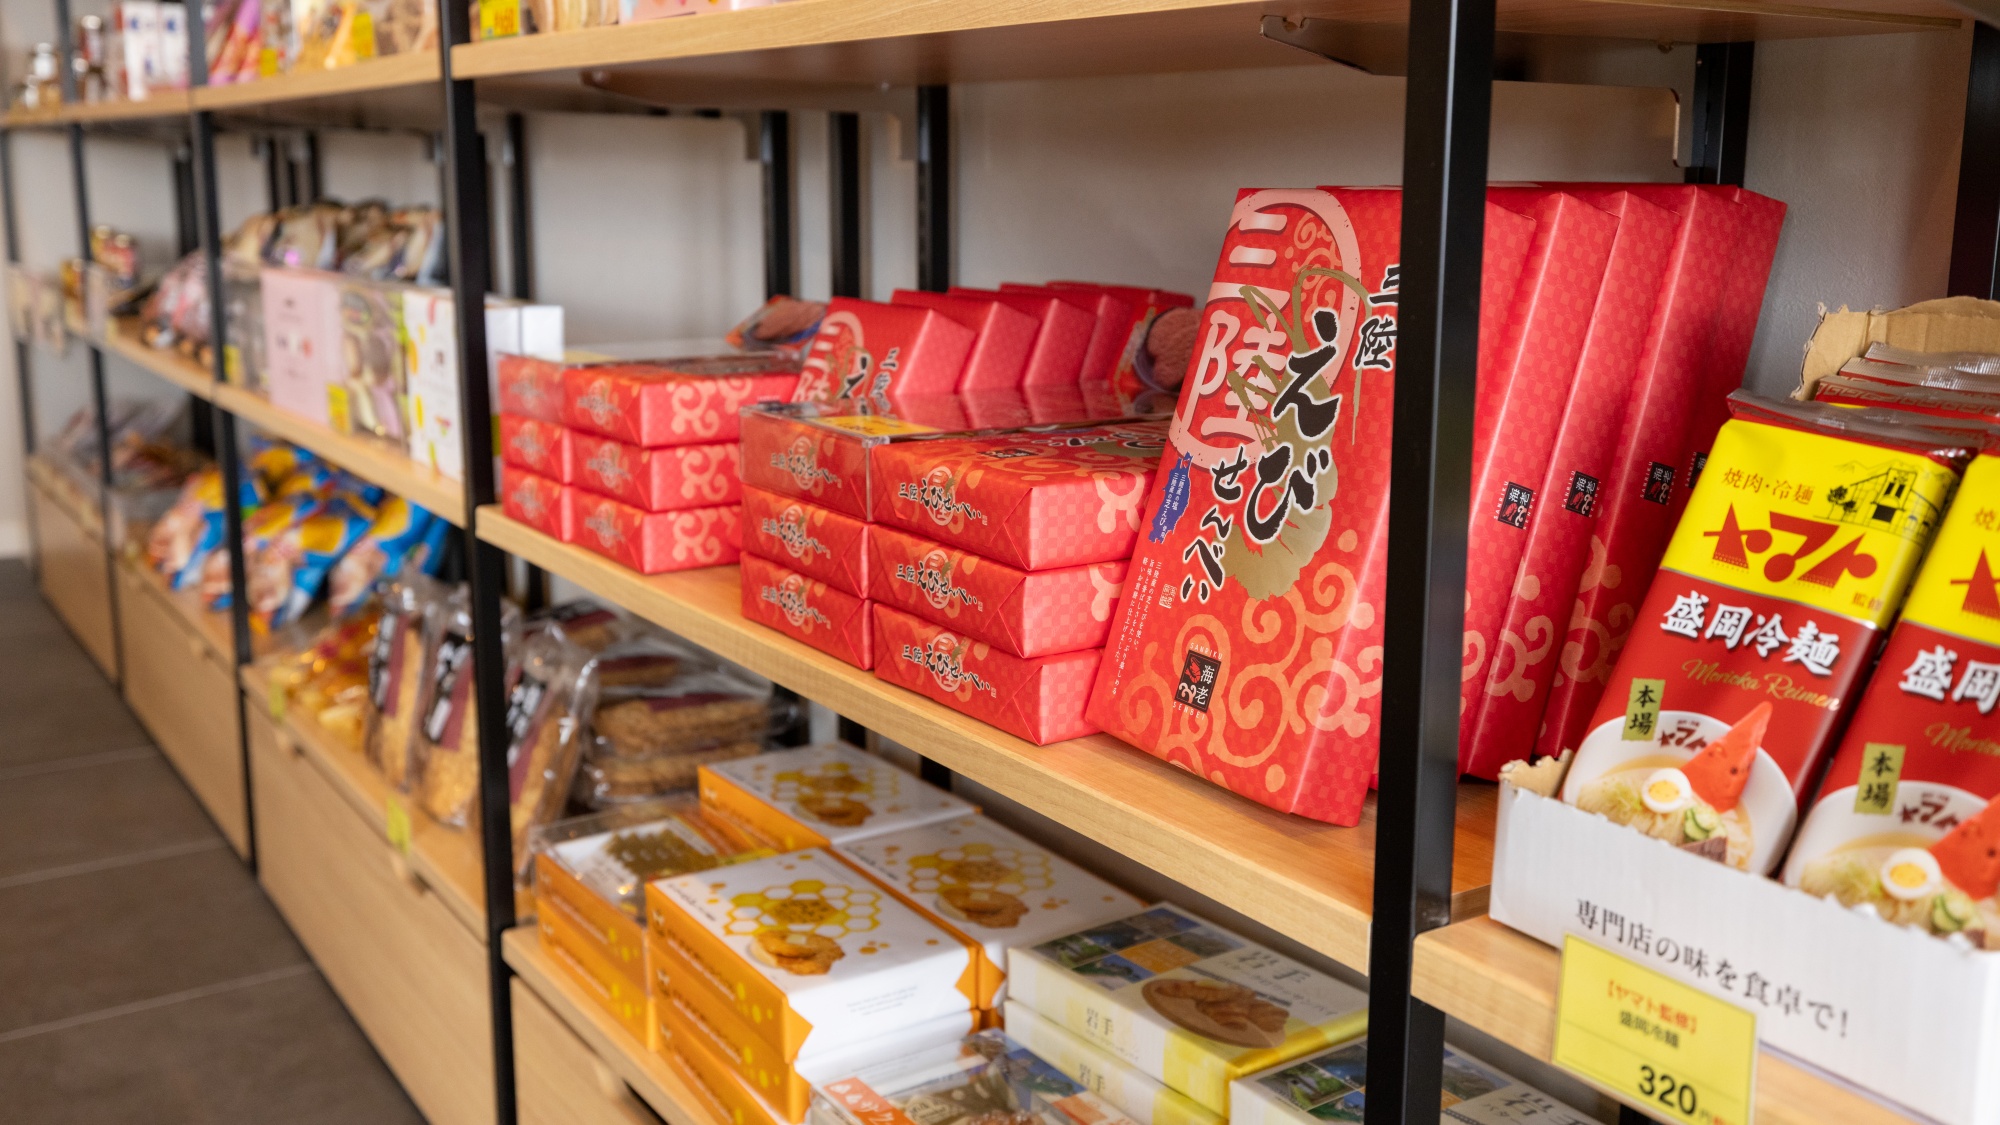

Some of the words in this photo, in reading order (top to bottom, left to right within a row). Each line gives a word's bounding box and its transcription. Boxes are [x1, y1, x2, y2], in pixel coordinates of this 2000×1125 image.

[1245, 309, 1341, 542] えび
[1180, 446, 1248, 601] せんべい
[1190, 643, 1223, 660] SANRIKU
[1660, 590, 1840, 676] 盛岡冷麺
[1195, 664, 1215, 705] 海老
[1629, 684, 1657, 735] 本場
[1681, 659, 1760, 690] Morioka
[1764, 673, 1840, 711] Reimen
[1173, 702, 1206, 720] SENBEI
[1862, 751, 1896, 811] 本場
[1638, 1064, 1698, 1116] 320
